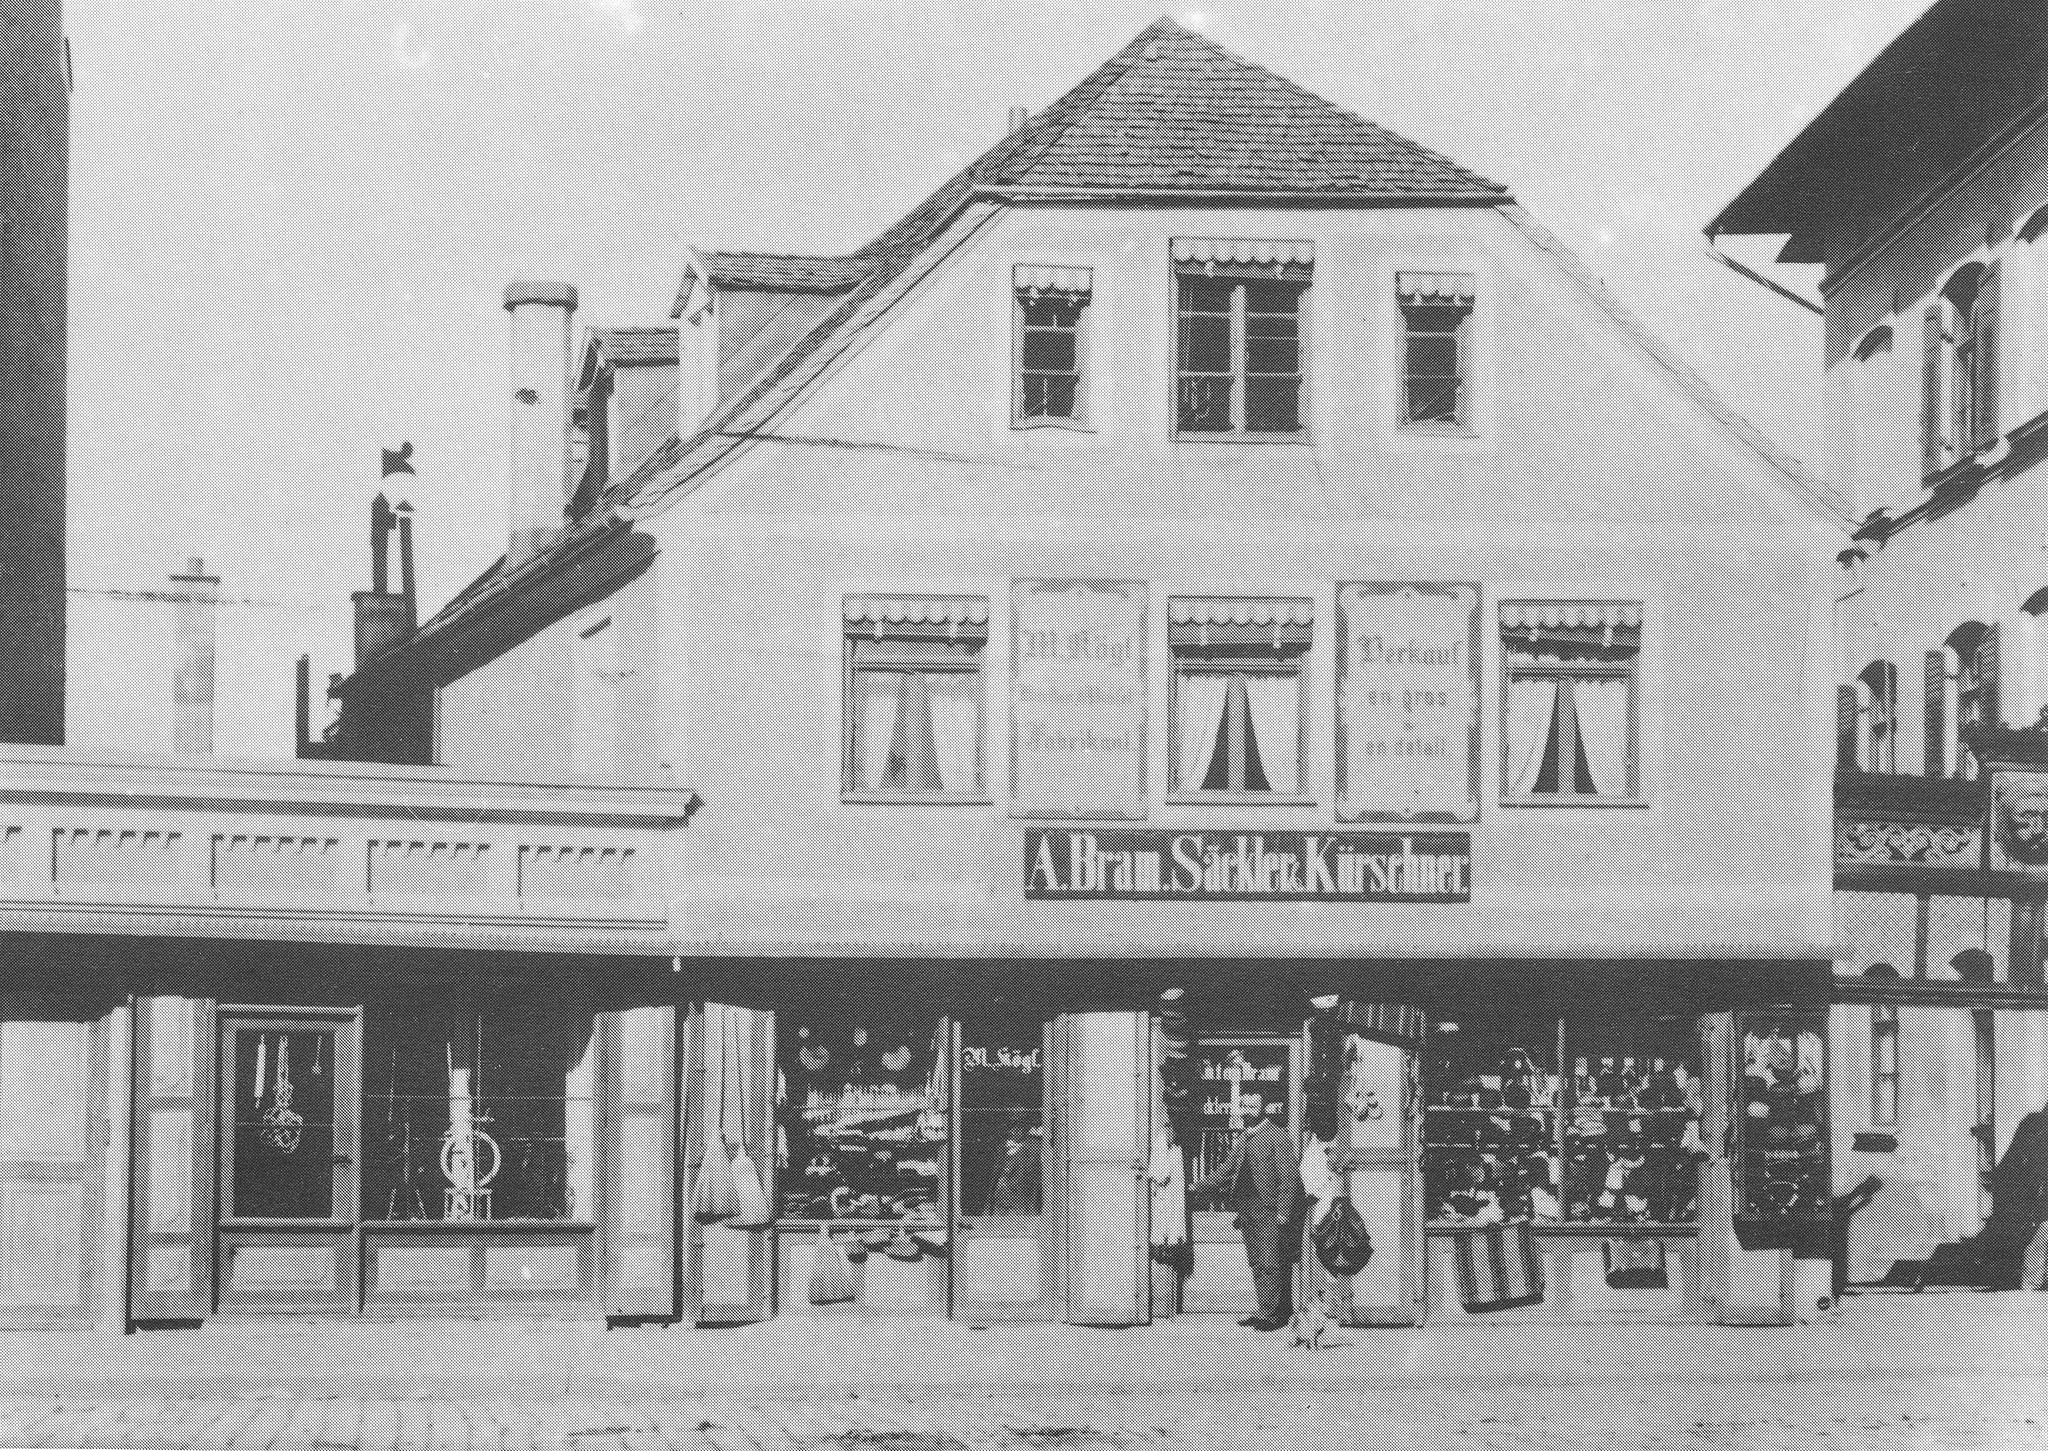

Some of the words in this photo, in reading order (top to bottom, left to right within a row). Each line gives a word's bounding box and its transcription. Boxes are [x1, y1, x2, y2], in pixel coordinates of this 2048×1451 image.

[1356, 634, 1463, 666] Verkauf
[1367, 689, 1392, 707] en
[1403, 689, 1448, 714] gros
[1365, 740, 1388, 757] en
[1170, 834, 1297, 893] Säckler
[1304, 836, 1470, 894] Kürschner.
